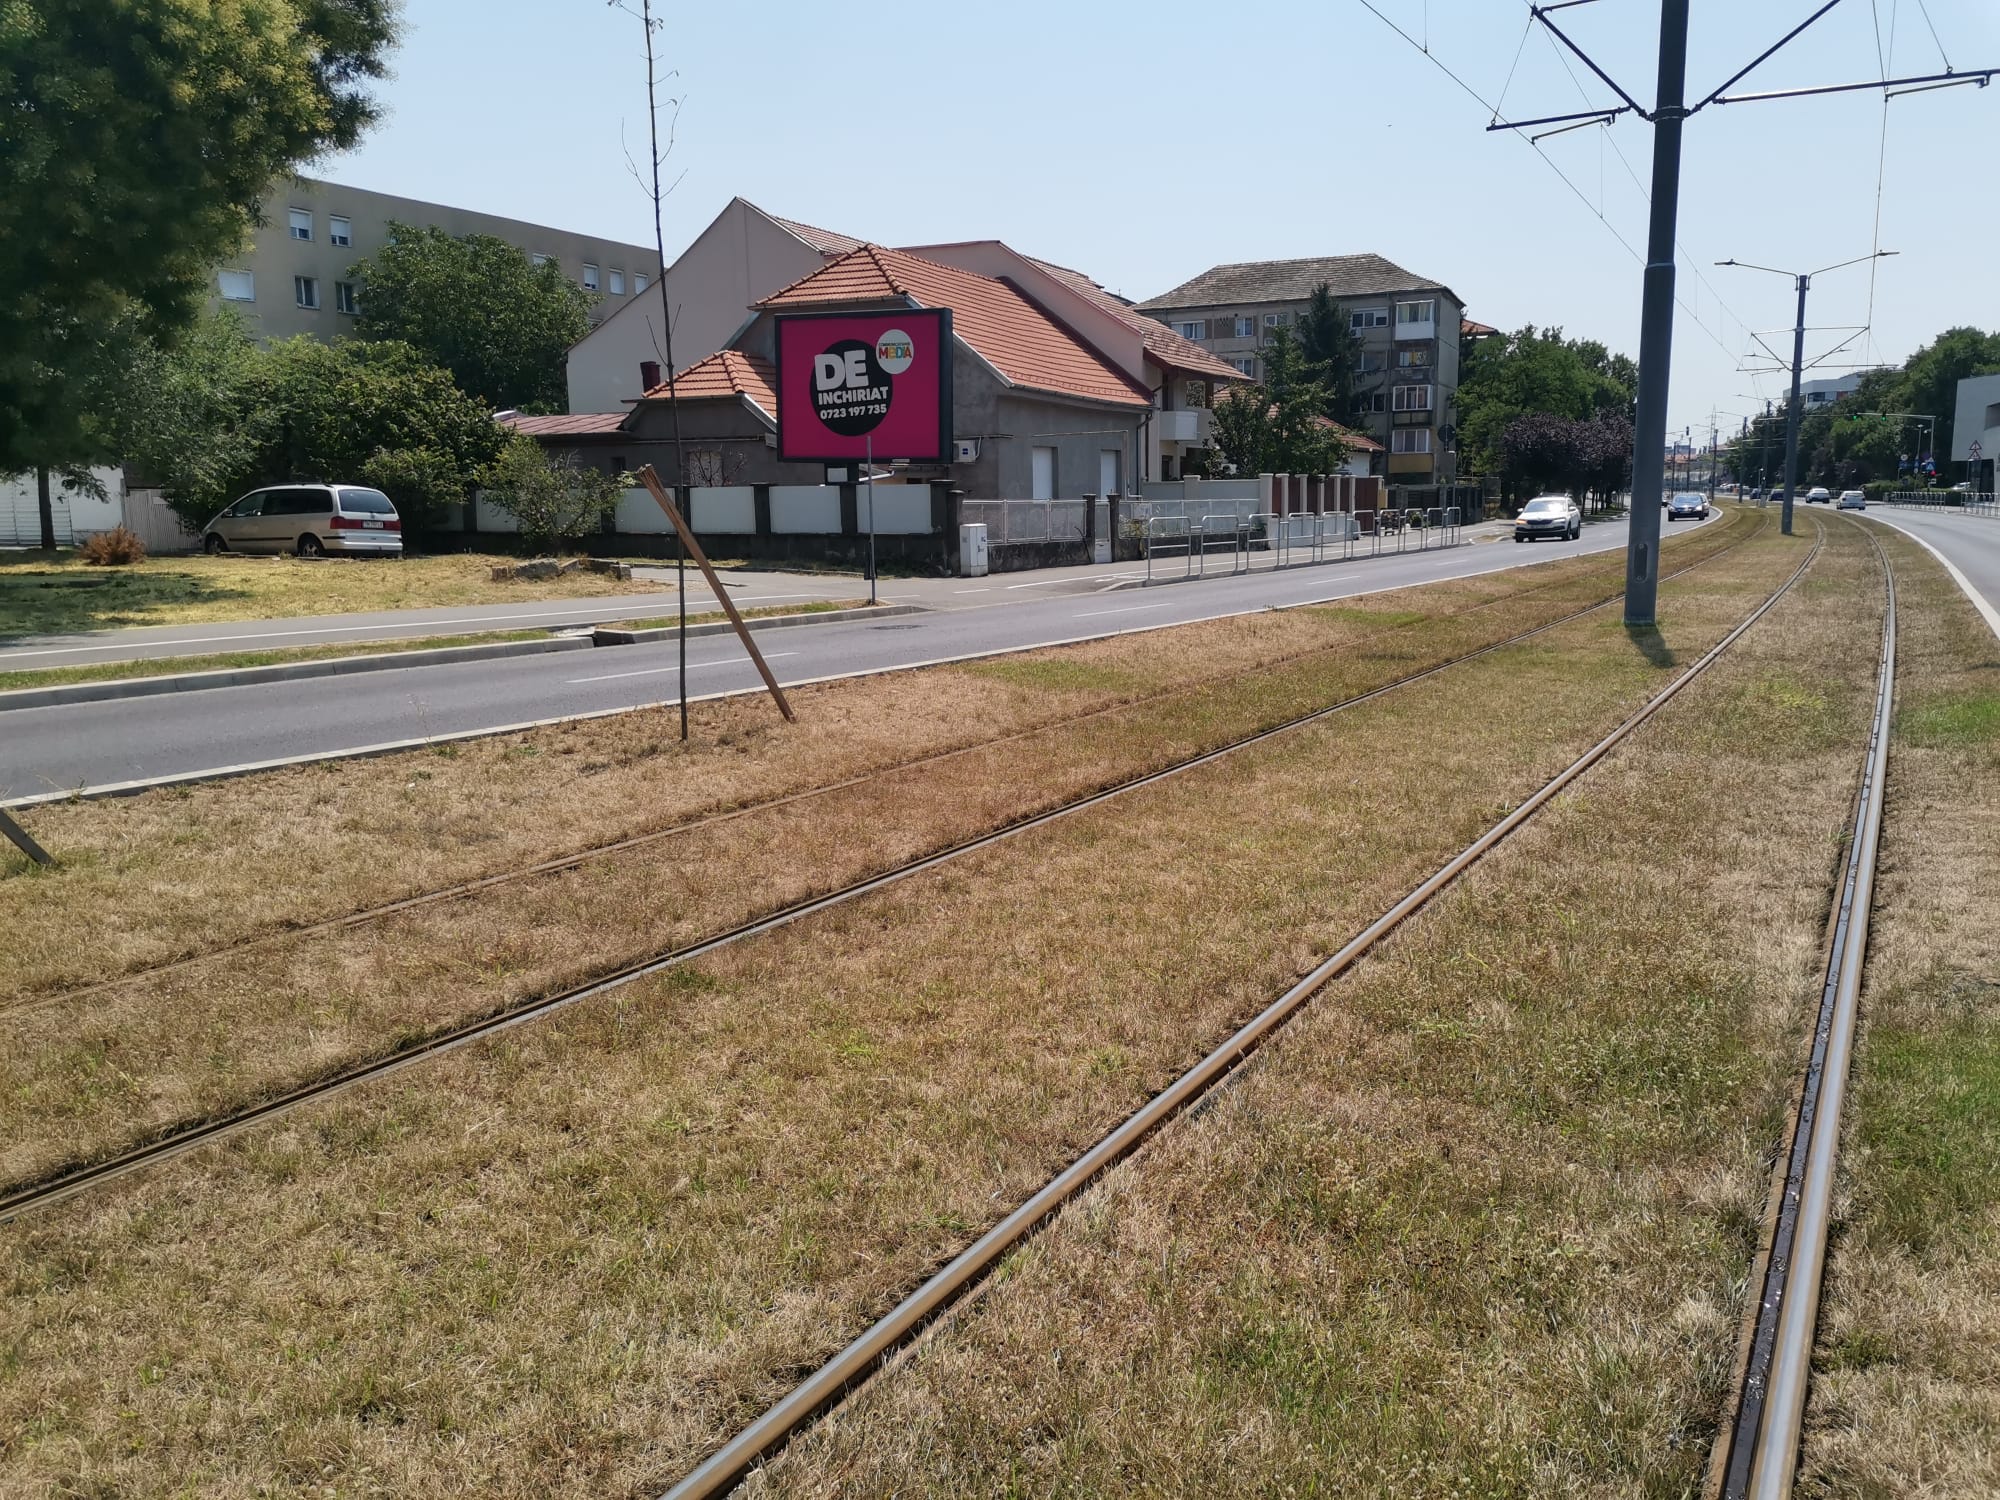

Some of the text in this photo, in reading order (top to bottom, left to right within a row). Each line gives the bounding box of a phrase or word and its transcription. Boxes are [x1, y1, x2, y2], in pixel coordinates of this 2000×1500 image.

[814, 350, 869, 391] DE
[818, 386, 889, 405] INCHIRIAT
[820, 404, 887, 420] 0723 197 735
